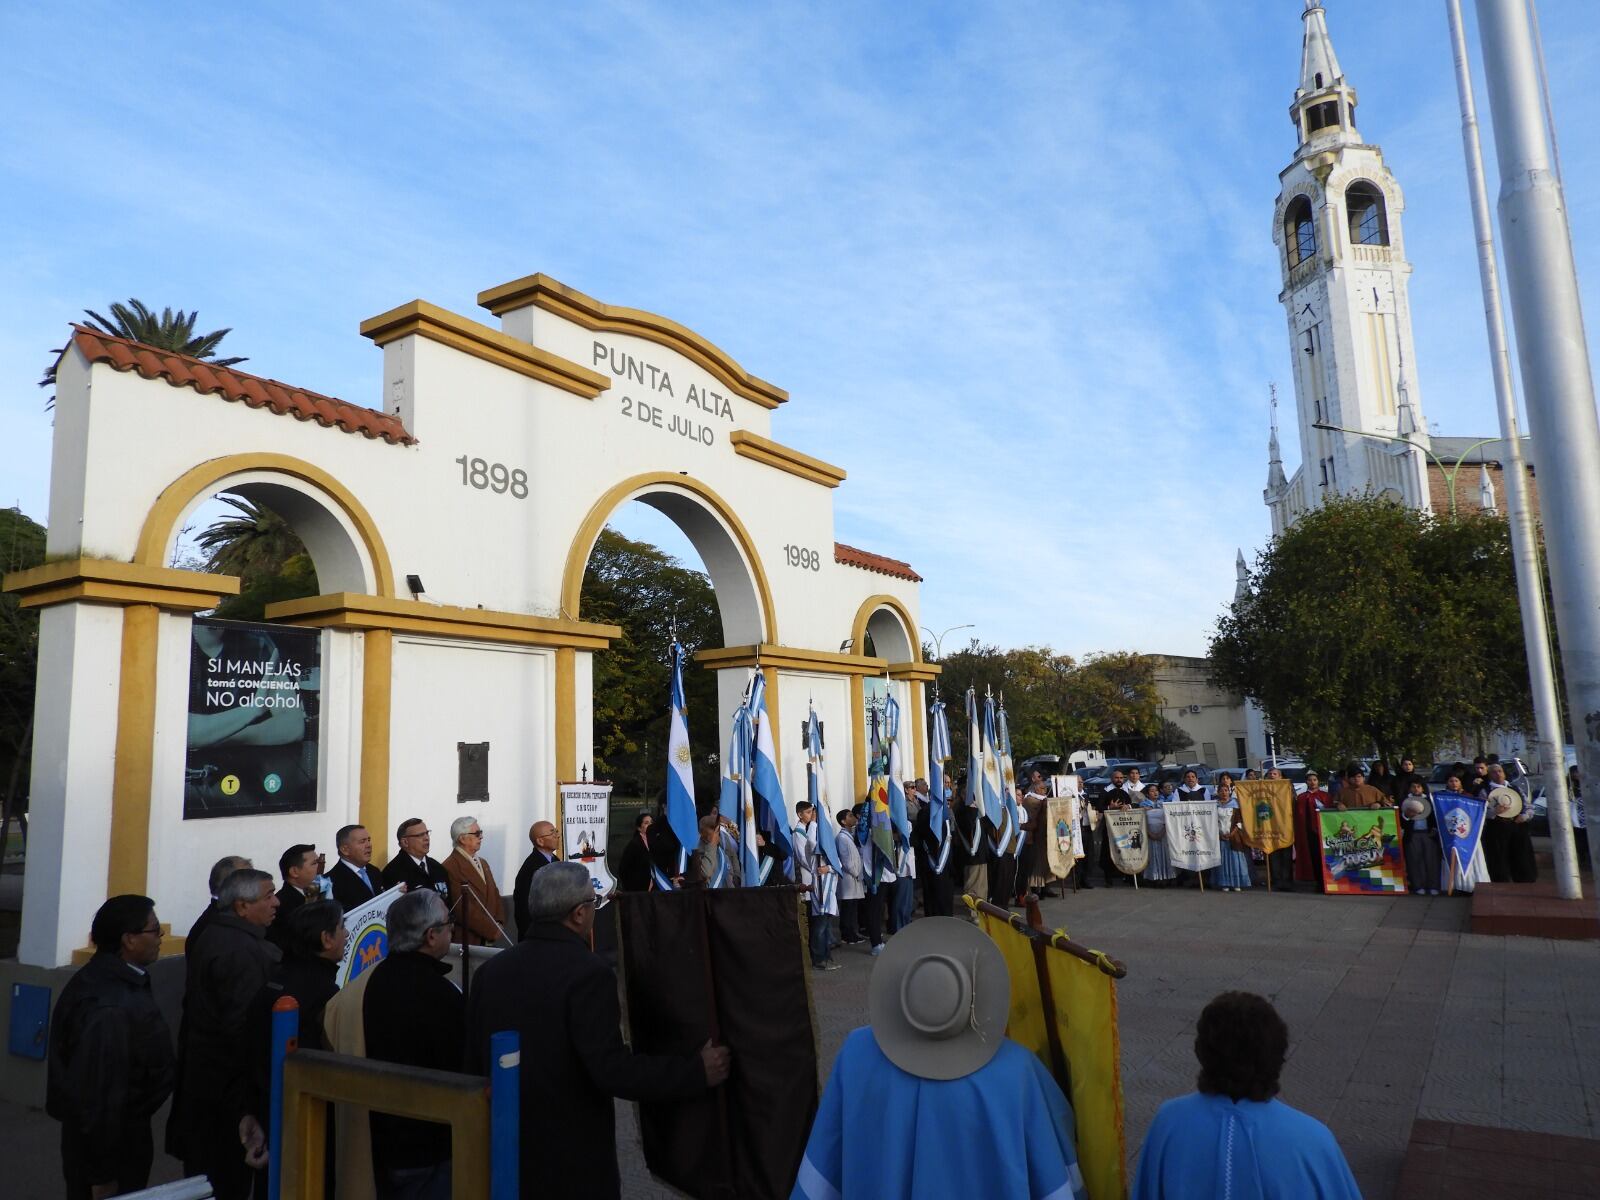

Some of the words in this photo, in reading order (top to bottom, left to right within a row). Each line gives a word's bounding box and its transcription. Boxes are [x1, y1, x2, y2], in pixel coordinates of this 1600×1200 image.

[593, 341, 674, 398] PUNTA
[685, 383, 735, 422] ALTA
[621, 396, 633, 417] 2
[638, 401, 663, 429] DE
[668, 414, 715, 447] JULIO
[455, 454, 529, 500] 1898
[783, 543, 821, 572] 1998
[207, 658, 222, 673] SI
[226, 659, 302, 677] MANEJÁS
[207, 678, 236, 688] tomá
[237, 680, 300, 690] CONCIENCIA
[206, 691, 235, 707] NO
[239, 693, 300, 708] alcohol
[227, 779, 234, 789] T
[344, 914, 368, 963] INSTITUTO
[367, 910, 376, 920] DE
